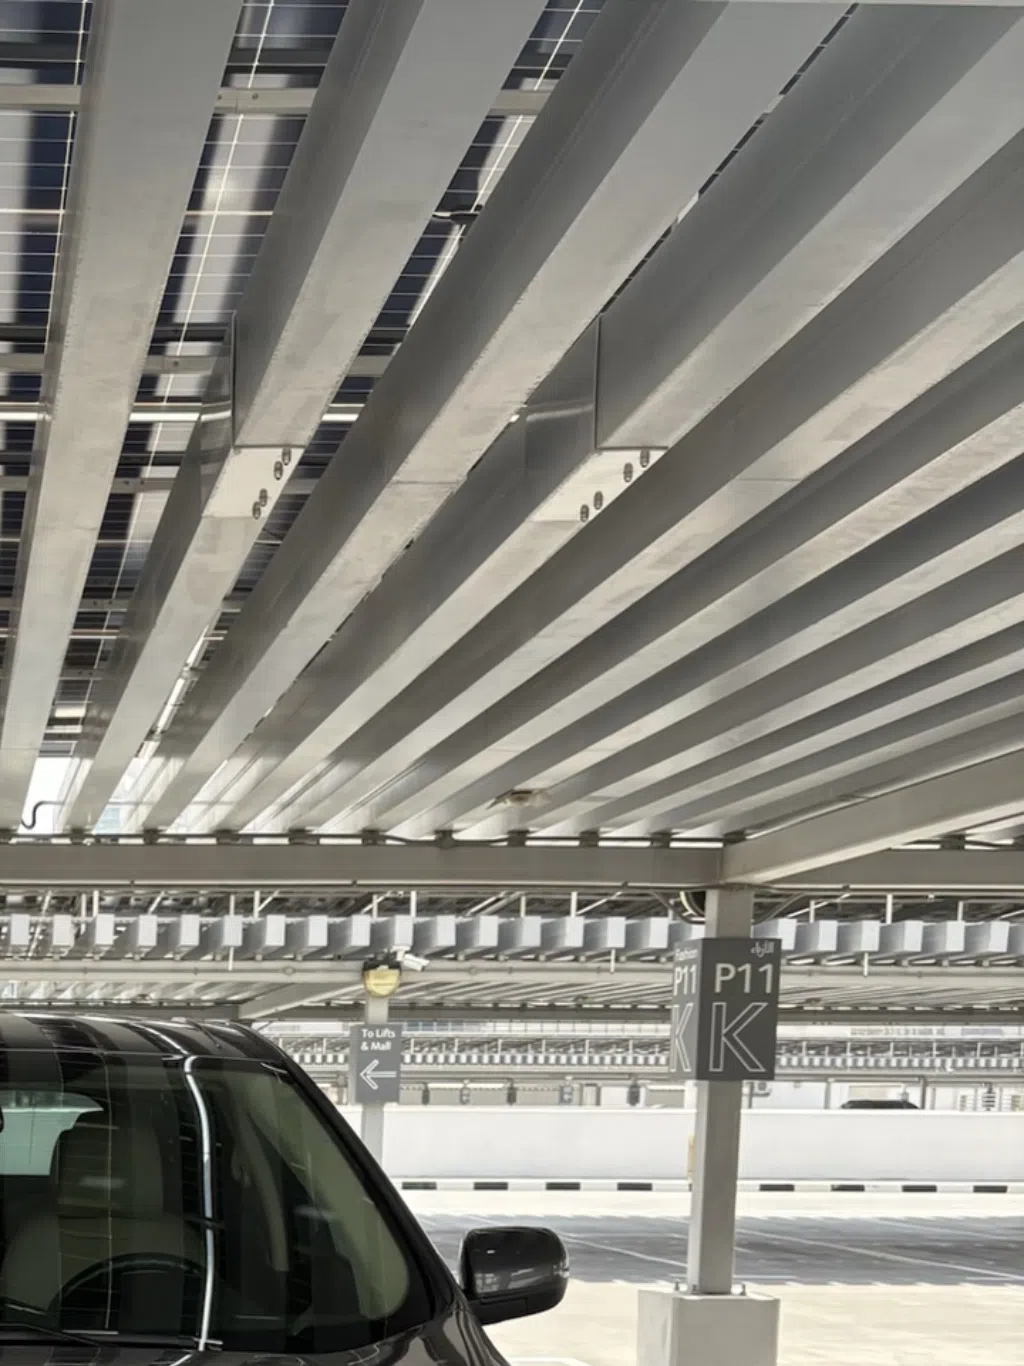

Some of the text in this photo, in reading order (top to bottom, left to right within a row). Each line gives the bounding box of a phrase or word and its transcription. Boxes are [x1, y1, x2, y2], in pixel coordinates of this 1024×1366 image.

[714, 963, 773, 994] P11
[360, 1041, 392, 1051] & Mall
[361, 1028, 396, 1038] To Lifts
[669, 1002, 694, 1072] K
[709, 1002, 769, 1072] K
